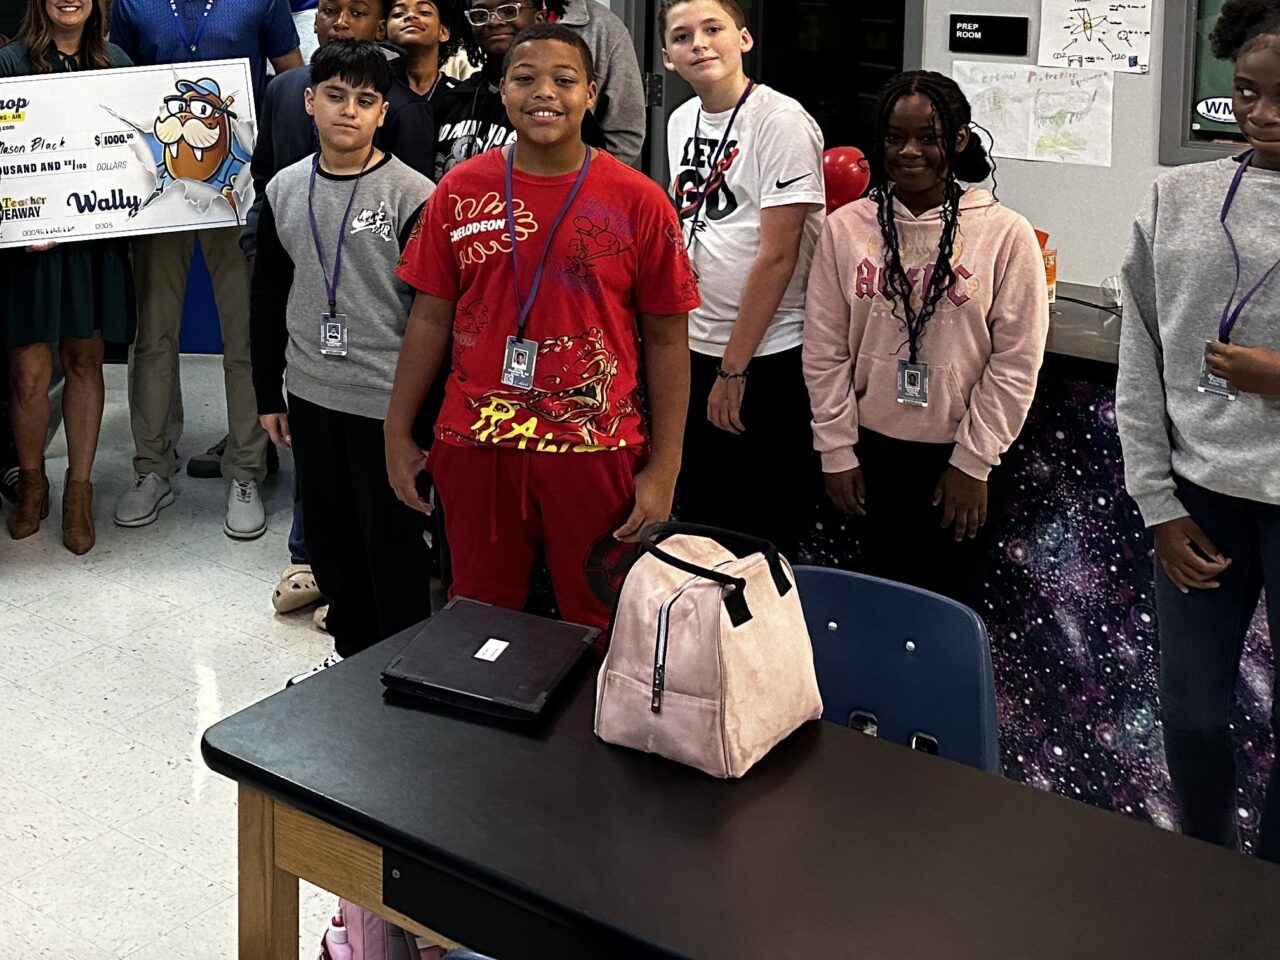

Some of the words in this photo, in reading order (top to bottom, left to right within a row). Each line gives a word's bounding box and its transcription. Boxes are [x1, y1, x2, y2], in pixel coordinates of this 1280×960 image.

[956, 22, 979, 31] PREP
[956, 30, 982, 39] ROOM
[1204, 100, 1234, 115] WM
[30, 136, 66, 153] Black
[94, 135, 101, 147] $
[40, 161, 61, 173] AND
[96, 161, 128, 172] DOLLARS
[2, 195, 47, 209] Teacher
[66, 188, 142, 218] Wally
